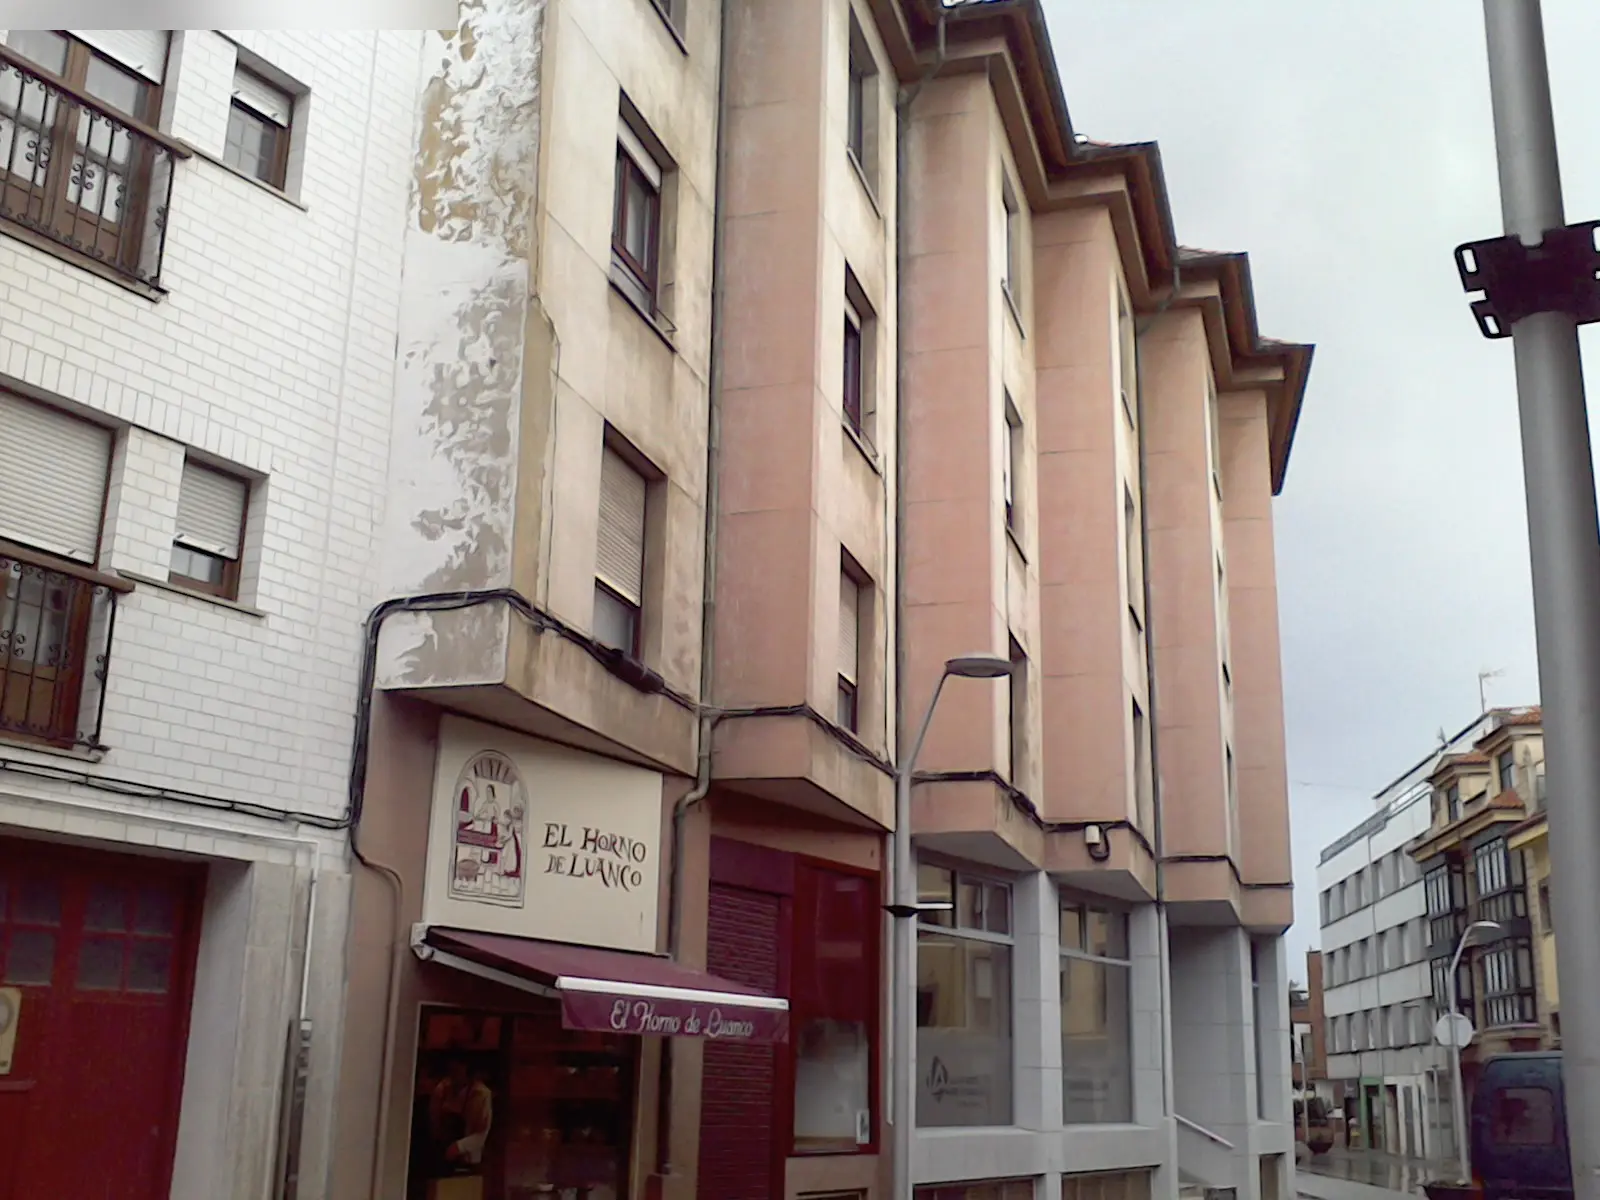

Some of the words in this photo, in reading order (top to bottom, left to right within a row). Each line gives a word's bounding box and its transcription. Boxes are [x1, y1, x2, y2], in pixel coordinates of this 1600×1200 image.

[542, 822, 572, 848] EL
[544, 853, 566, 874] DE
[610, 999, 630, 1030] El
[633, 1001, 681, 1033] Horno
[684, 1007, 701, 1034] de
[703, 1008, 754, 1038] Luanco
